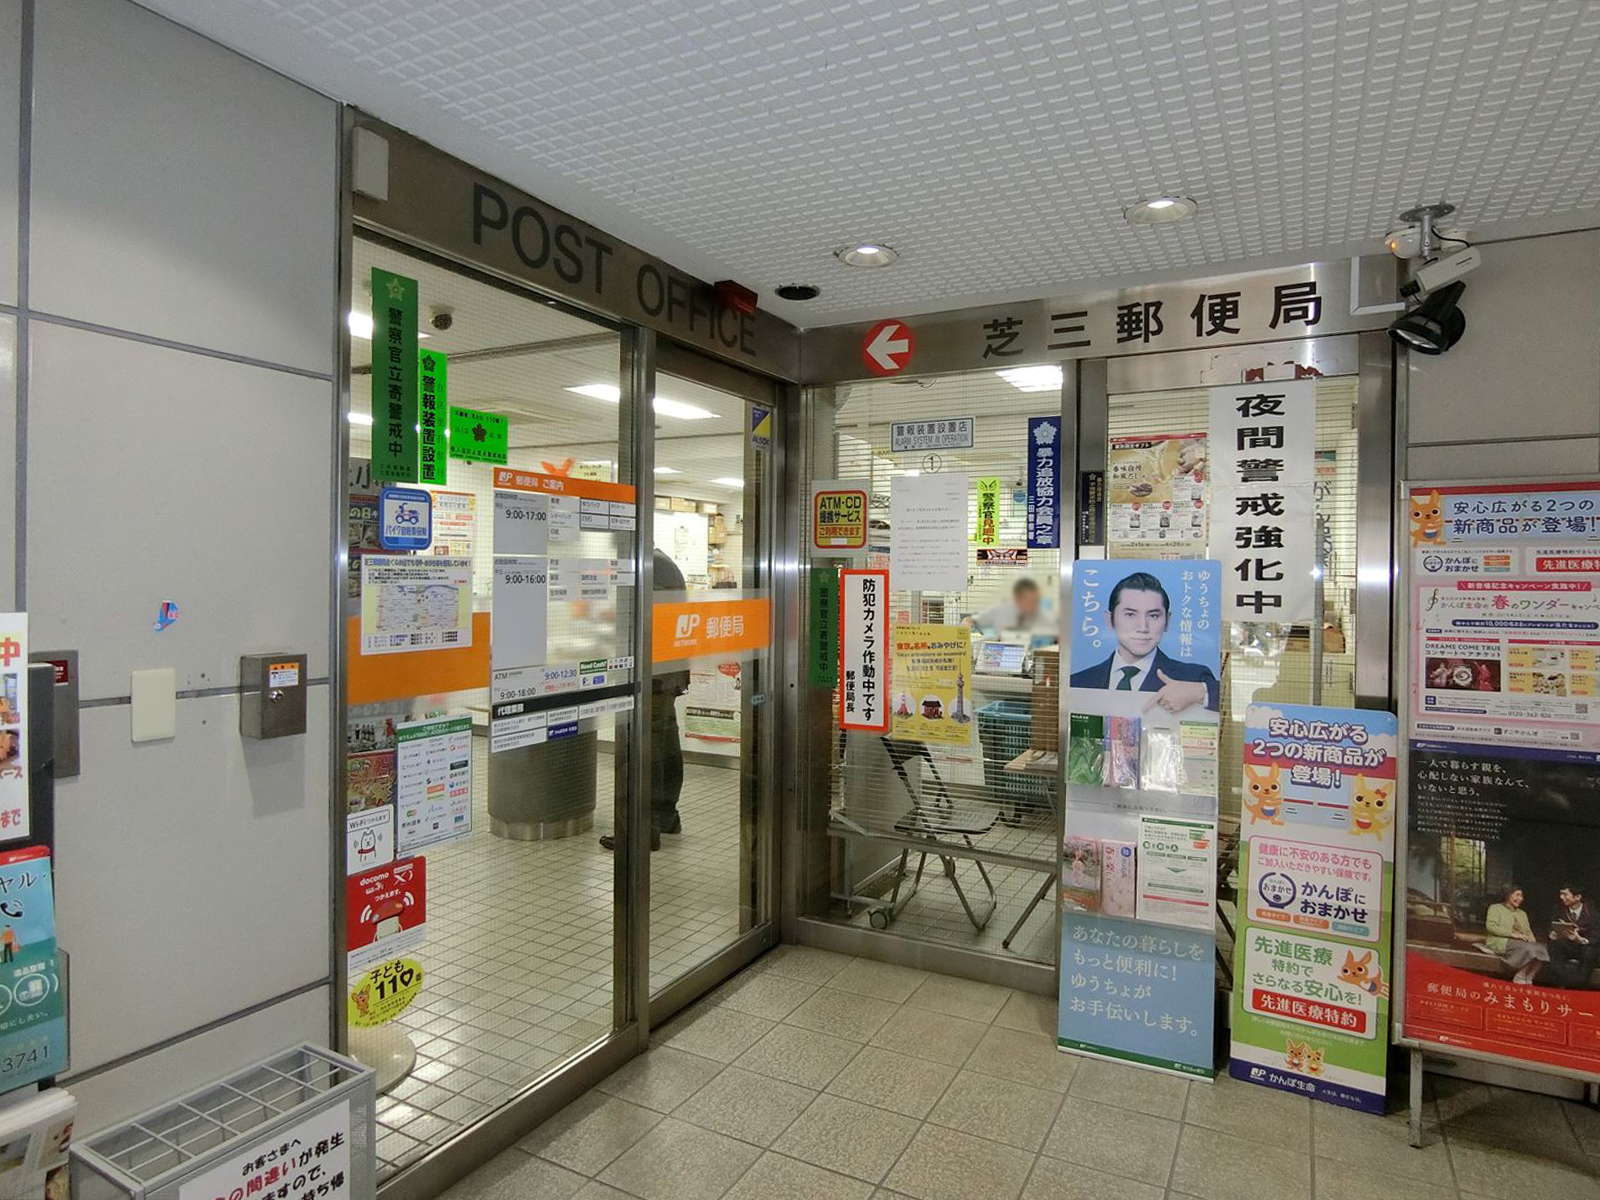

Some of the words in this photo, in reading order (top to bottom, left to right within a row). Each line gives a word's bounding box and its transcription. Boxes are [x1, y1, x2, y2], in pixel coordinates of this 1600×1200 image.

[473, 181, 613, 295] POST
[636, 263, 757, 357] OFFICE
[982, 280, 1323, 359] 芝三郵便局
[388, 306, 403, 459] 警察官立寄警戒中
[516, 475, 538, 487] 郵便局
[506, 509, 547, 521] 9:00-17:00
[1234, 393, 1286, 615] 夜間警戒強化中
[1453, 499, 1595, 515] 安心広がる2つの
[505, 573, 546, 585] 9:00-16:00
[1081, 569, 1102, 648] こちら。
[1197, 570, 1211, 630] ゆうちょの
[706, 615, 744, 639] 郵便局
[1180, 570, 1194, 658] おトクな情報は
[862, 578, 876, 722] 防犯カメラ作動中です
[494, 672, 508, 680] ATM
[545, 669, 577, 680] 9:00-12:30
[500, 687, 536, 699] 9:00-18:00
[846, 670, 856, 713] 郵便局長
[1269, 718, 1368, 744] 安心広がる
[1252, 738, 1387, 768] 2つの新商品が
[1417, 759, 1507, 775] 一人で暮らす親を、
[1417, 770, 1530, 789] 心配しない家族なんて、
[1417, 784, 1481, 797] いないと思う。
[1, 808, 22, 828] まで
[1258, 842, 1372, 870] 健康に不安のある方でも
[360, 871, 389, 886] docomo
[1257, 857, 1373, 883] ご加入いただきやすい保険です。
[1300, 881, 1367, 905] かんぽに
[1299, 899, 1368, 924] おまかせ
[1073, 925, 1205, 961] あなたの暮らしを
[1254, 936, 1333, 966] 先進医療
[370, 960, 404, 984] 子ども
[1271, 958, 1314, 977] 特約で
[1071, 973, 1152, 999] ゆうちょが
[1261, 993, 1358, 1028] 先進医療特約
[1426, 982, 1595, 1017] 郵便局のみまもりサー
[1069, 996, 1198, 1037] お手伝いします。
[1268, 1073, 1316, 1093] かんぽ生命
[214, 1132, 345, 1200] の間違いが発生
[242, 1138, 302, 1176] お客さまへ
